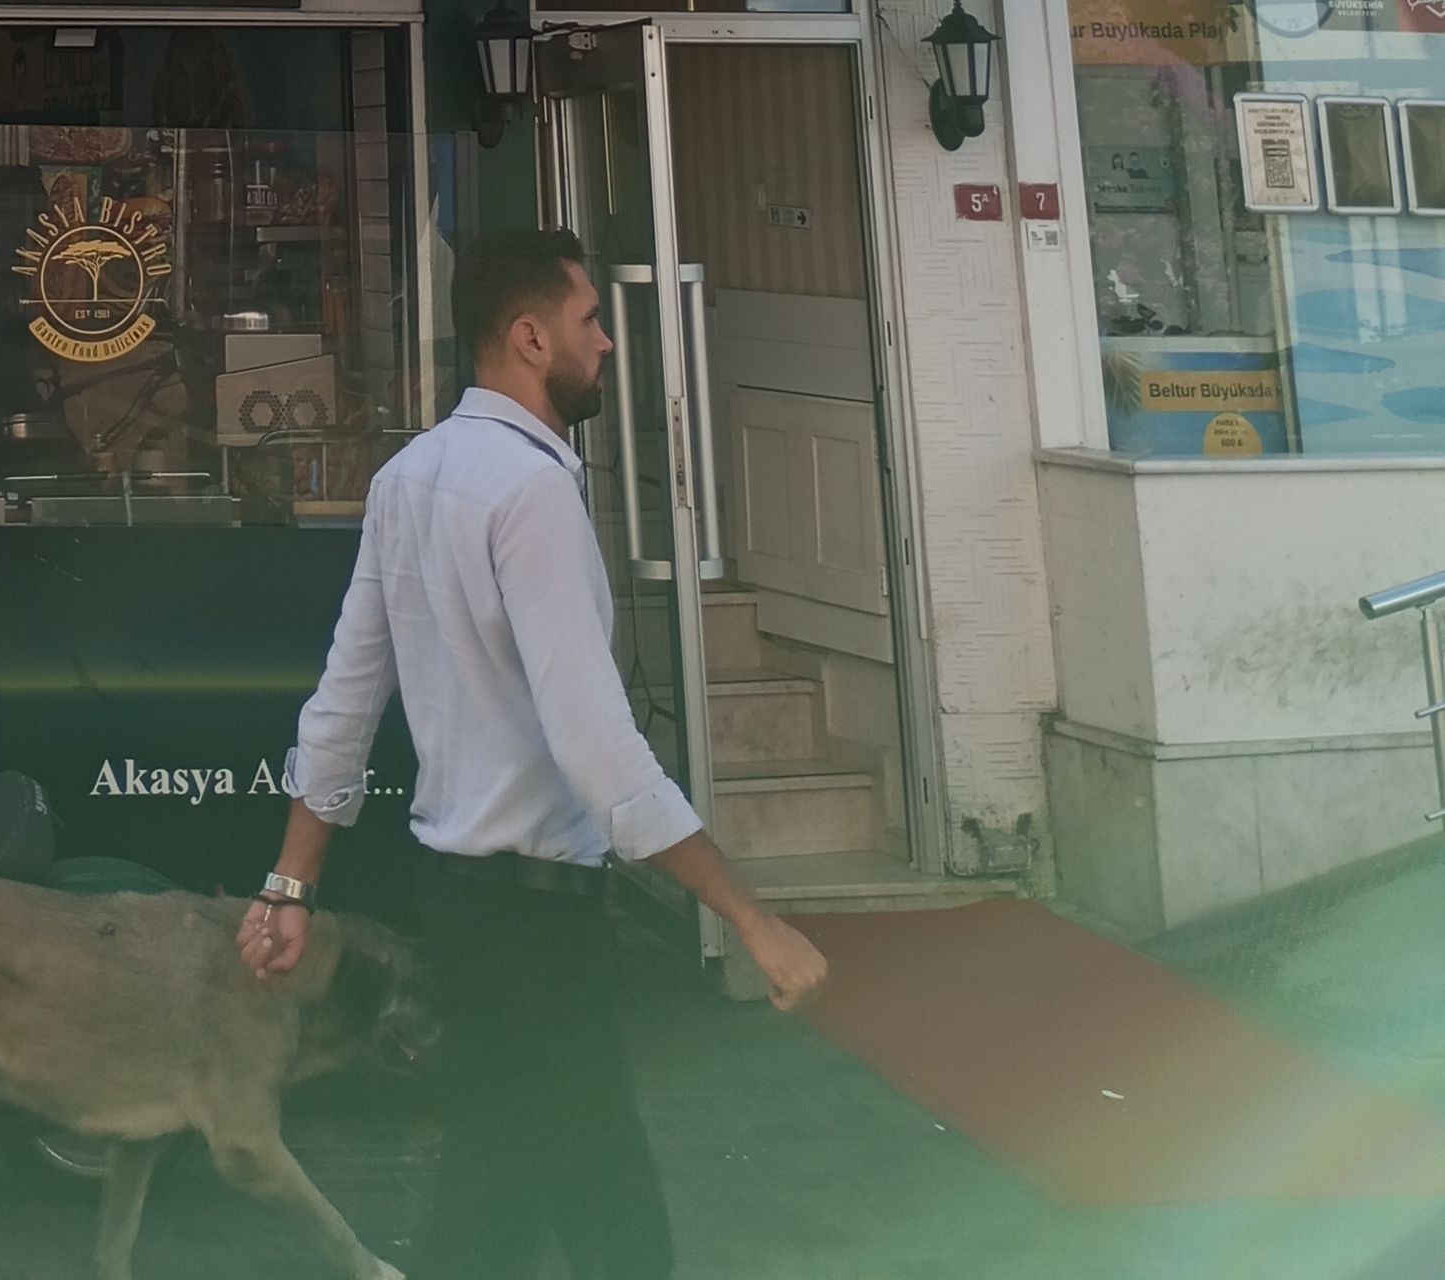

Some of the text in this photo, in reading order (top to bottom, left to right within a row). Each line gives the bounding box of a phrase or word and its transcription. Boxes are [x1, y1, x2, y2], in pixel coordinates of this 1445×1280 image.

[1091, 21, 1184, 42] Büyükada
[1035, 191, 1046, 211] 7
[11, 196, 172, 276] AKASYA BISTRO
[74, 309, 91, 320] EST
[35, 320, 68, 352] Gastro
[71, 341, 100, 358] Food
[1148, 382, 1196, 399] Beltur
[1200, 382, 1273, 401] Büyükada
[88, 759, 236, 805] Akasya
